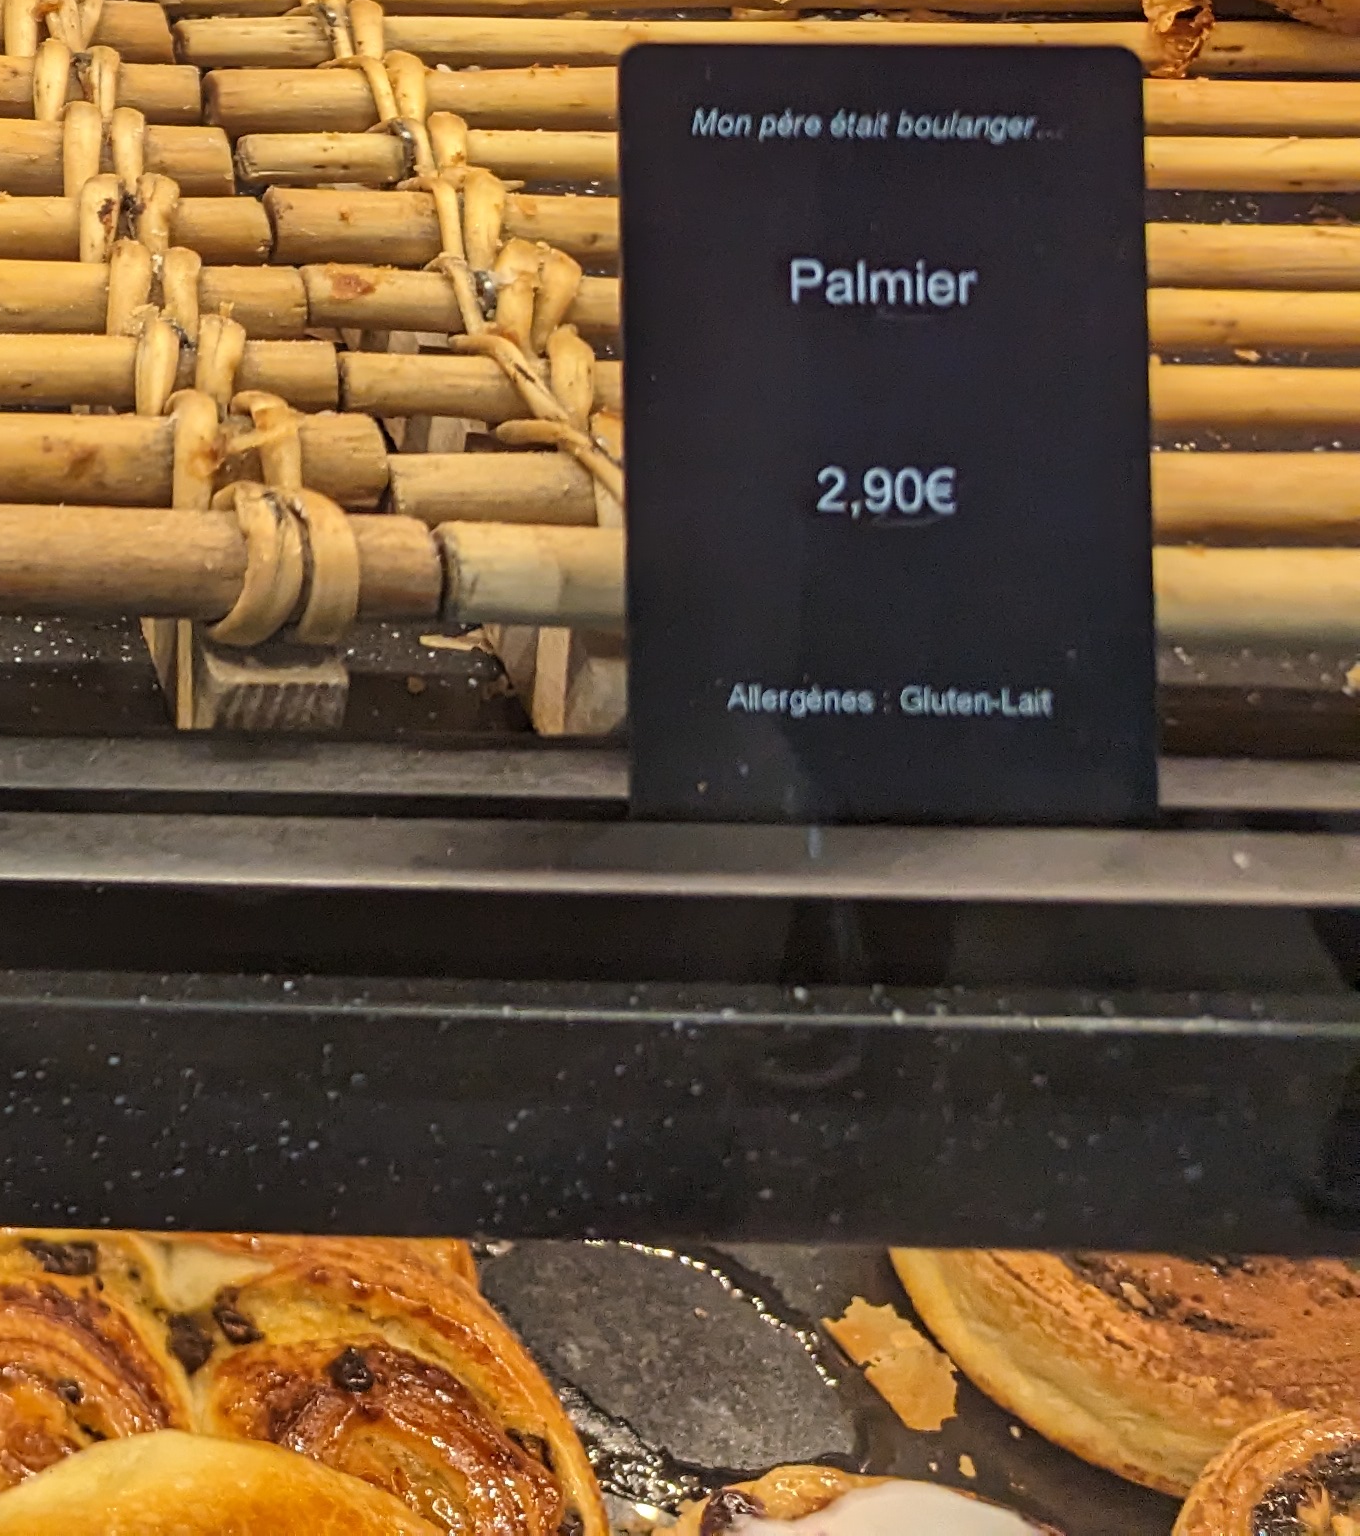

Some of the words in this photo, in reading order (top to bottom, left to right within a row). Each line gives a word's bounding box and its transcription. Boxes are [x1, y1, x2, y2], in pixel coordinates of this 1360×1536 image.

[690, 106, 752, 138] Mon
[830, 106, 889, 140] était
[789, 257, 979, 307] Palmier
[816, 465, 958, 520] 2,90€
[899, 682, 1055, 716] Gluten-Lait
